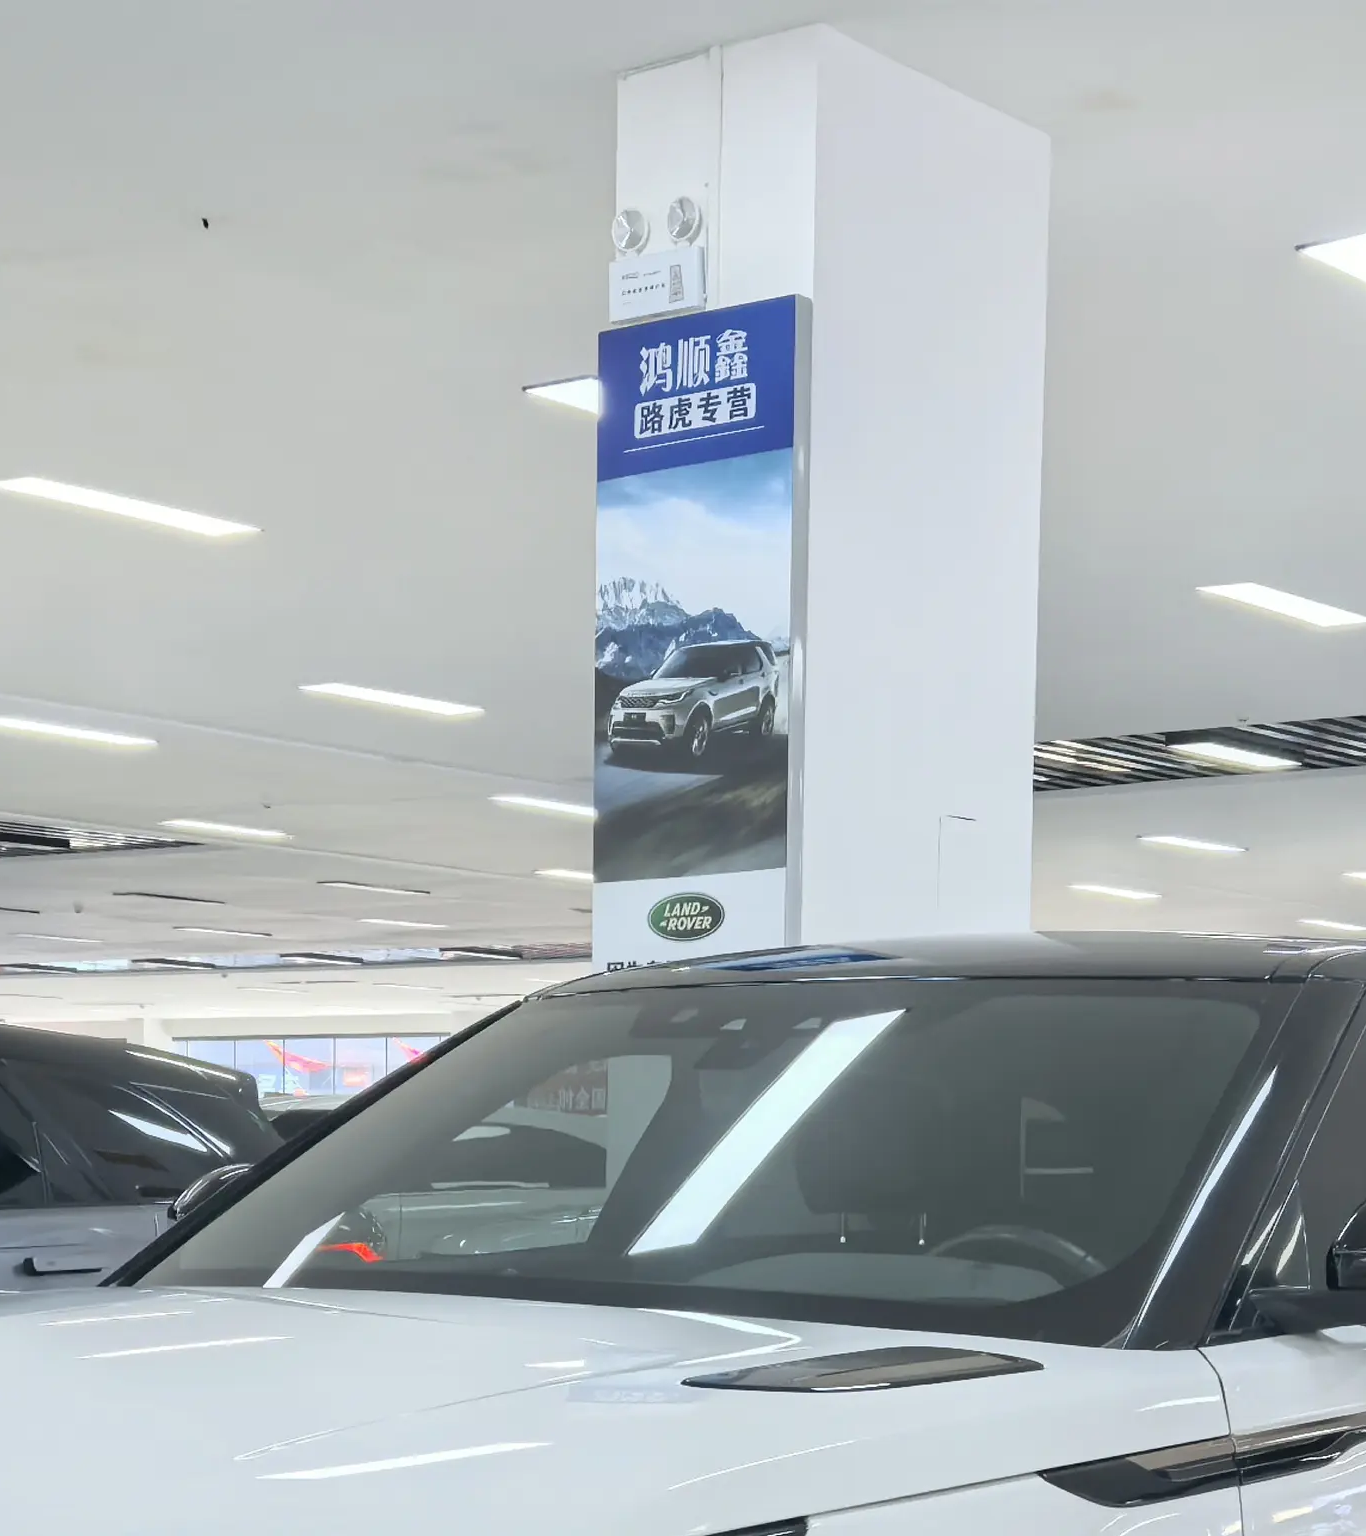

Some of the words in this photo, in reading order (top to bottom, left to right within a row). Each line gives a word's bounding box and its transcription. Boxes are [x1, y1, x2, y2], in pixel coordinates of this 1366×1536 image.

[639, 329, 748, 396] 鸿顺鑫
[639, 386, 752, 435] 路虎专营
[663, 902, 701, 917] LAND
[667, 916, 712, 931] ROVER
